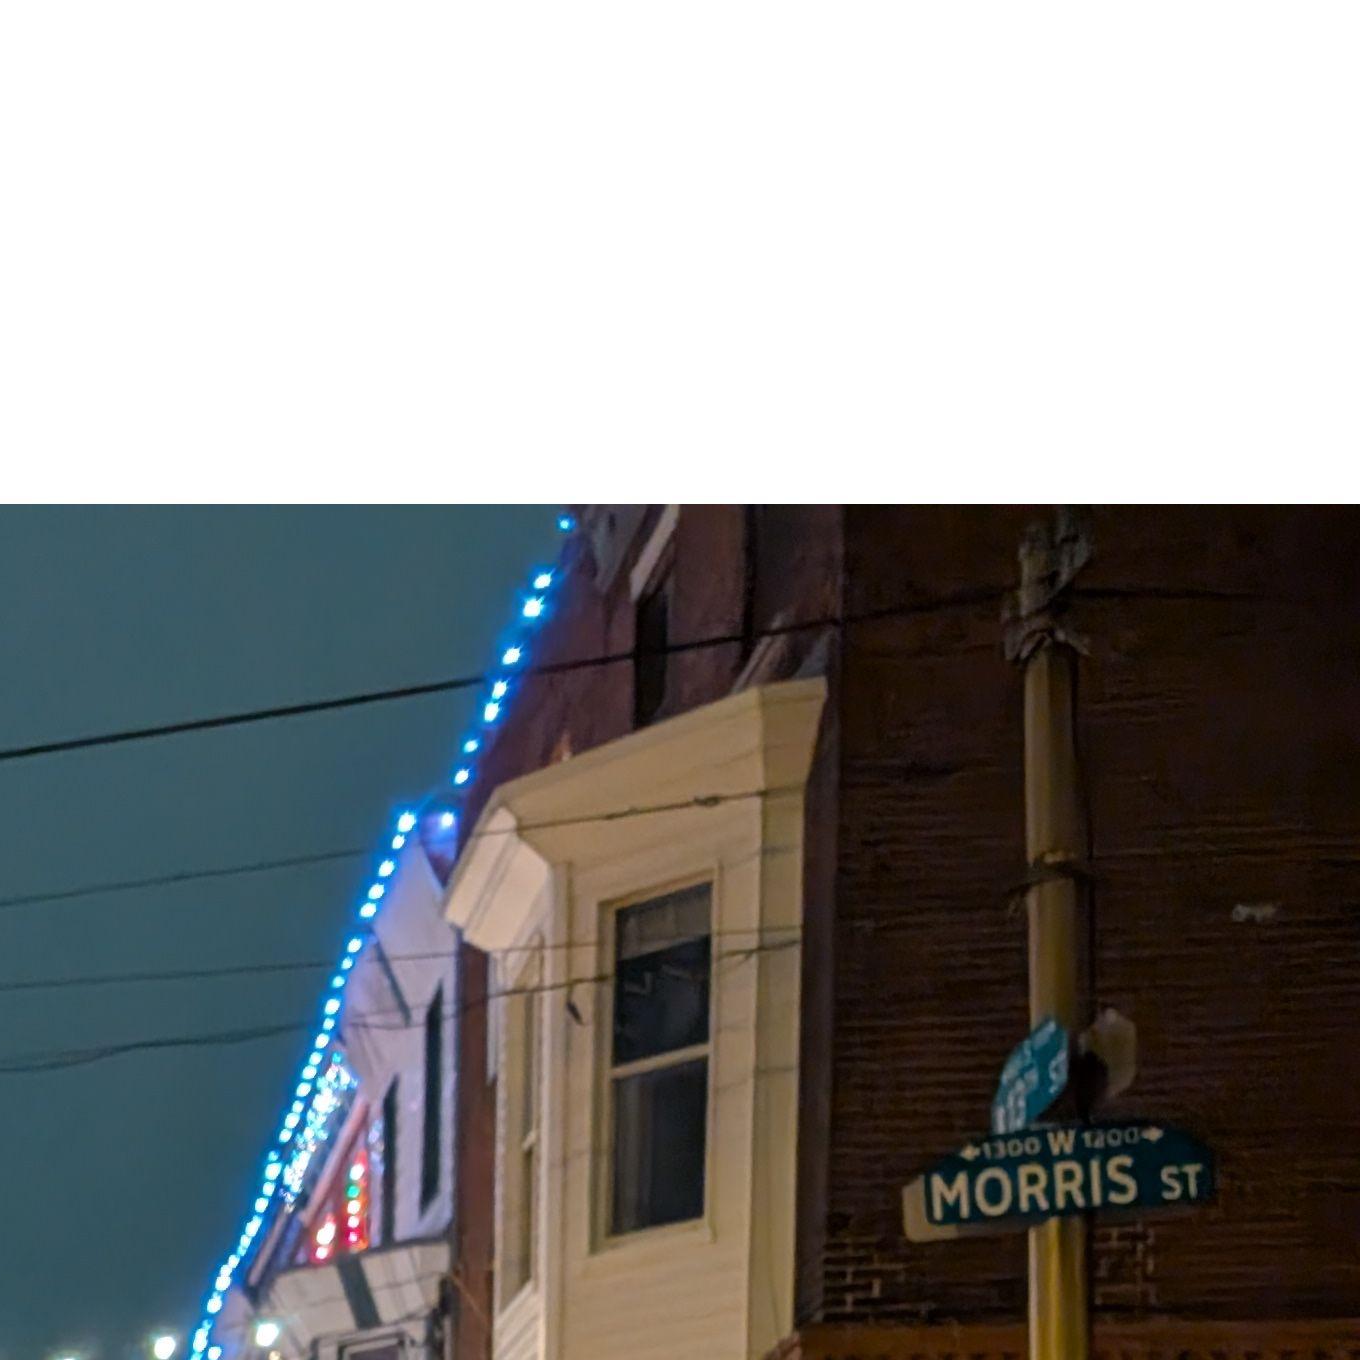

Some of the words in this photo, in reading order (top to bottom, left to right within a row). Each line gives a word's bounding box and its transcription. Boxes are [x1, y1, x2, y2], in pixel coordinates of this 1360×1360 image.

[1047, 1129, 1076, 1156] W
[931, 1155, 1138, 1221] MORRIS
[1161, 1163, 1203, 1201] ST
